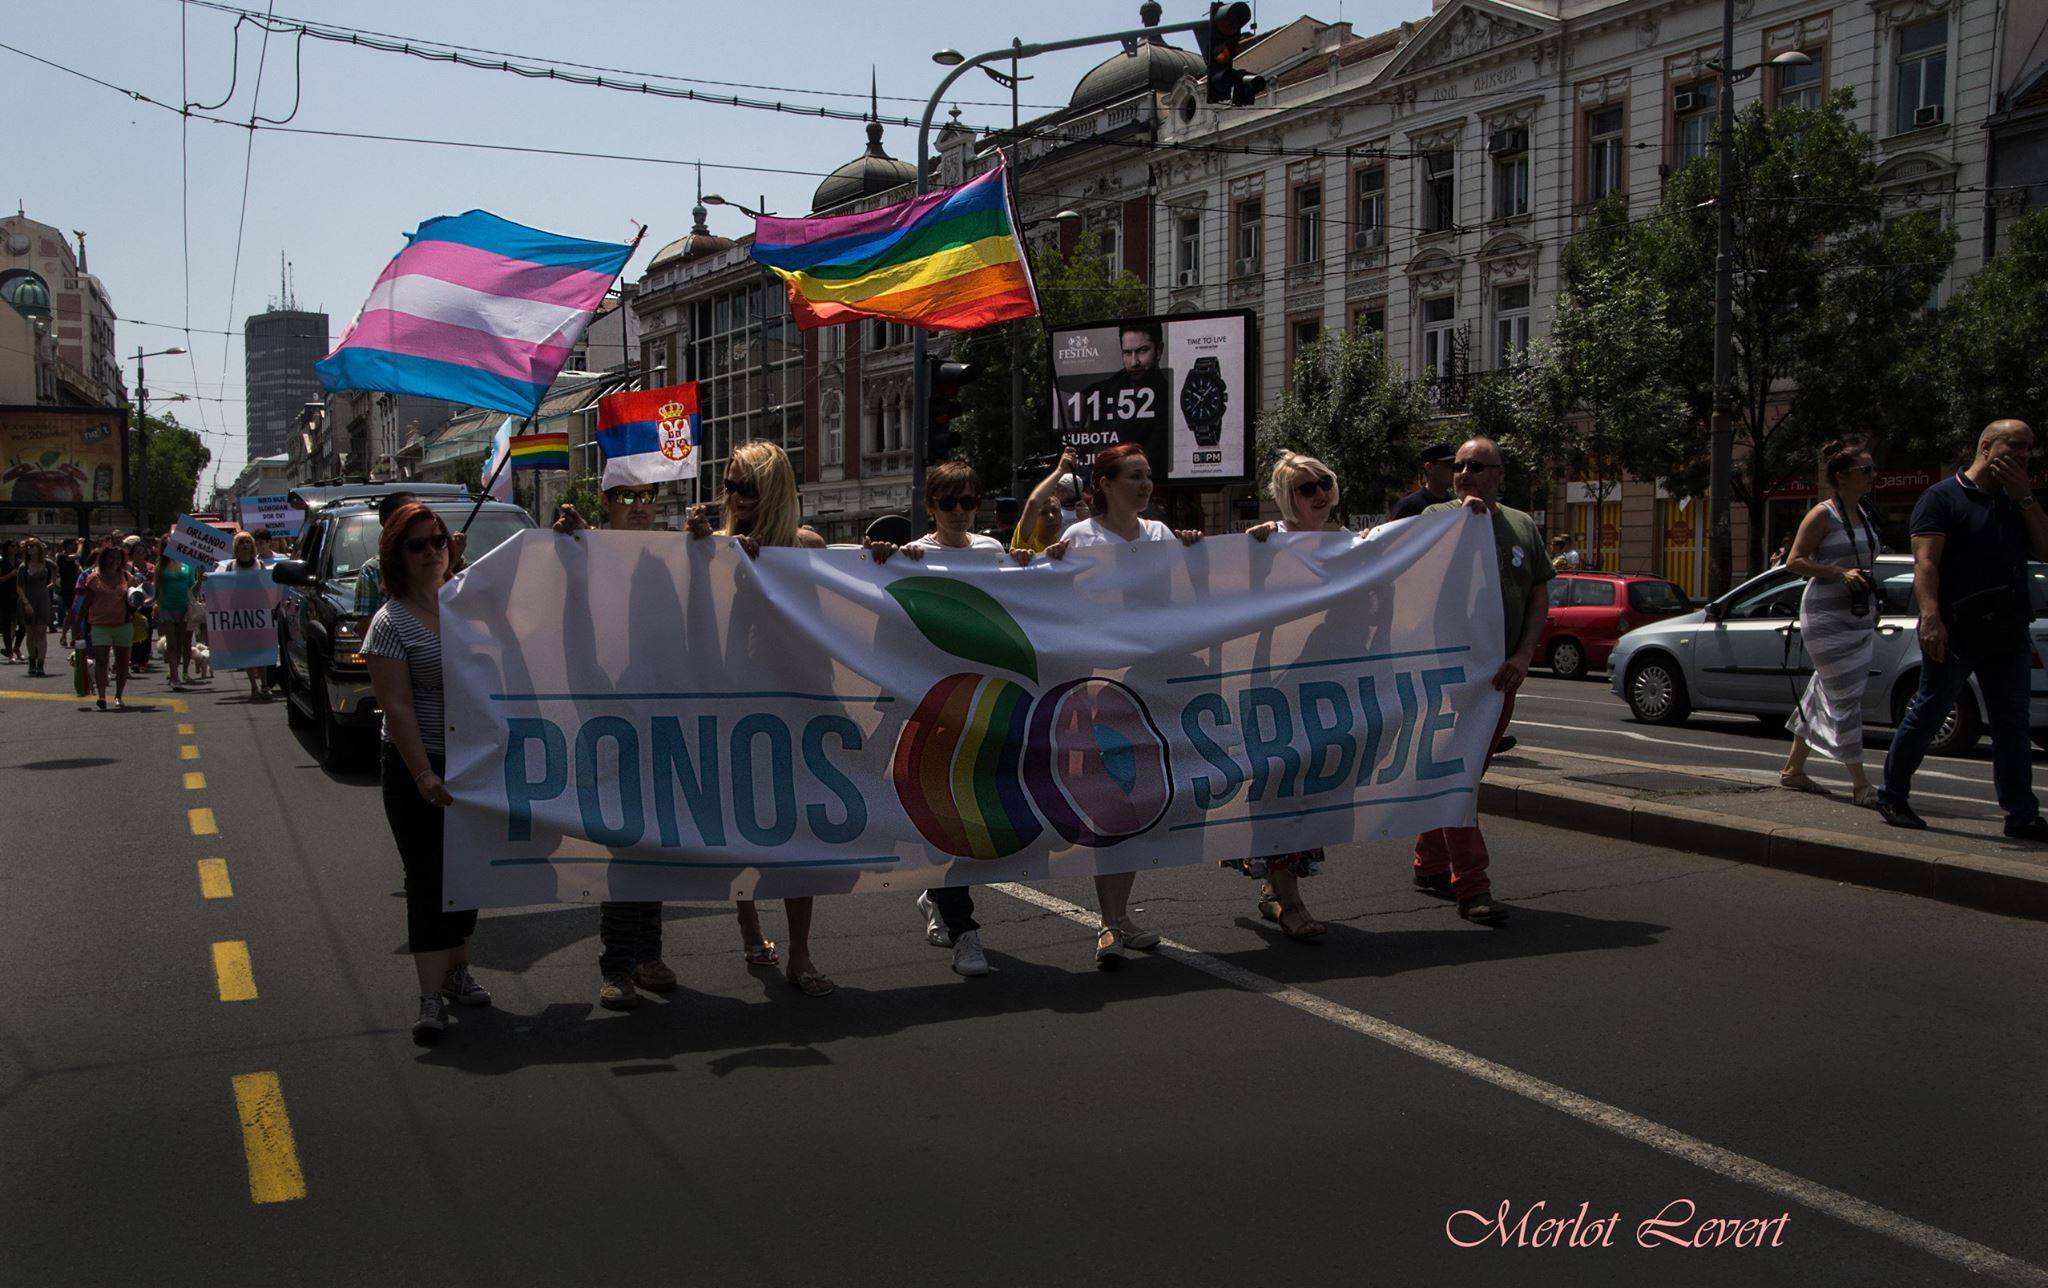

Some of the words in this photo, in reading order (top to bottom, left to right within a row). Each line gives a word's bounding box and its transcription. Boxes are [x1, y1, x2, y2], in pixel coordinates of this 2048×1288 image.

[1187, 337, 1201, 345] TIME
[1203, 336, 1213, 344] TO
[1213, 335, 1227, 343] LIVE
[1058, 347, 1099, 360] FESTINA
[1067, 387, 1156, 422] 11:52
[186, 526, 226, 550] ORLANDO
[208, 609, 266, 630] TRANS
[504, 716, 867, 848] PONOS
[1179, 668, 1466, 810] SRBIJE
